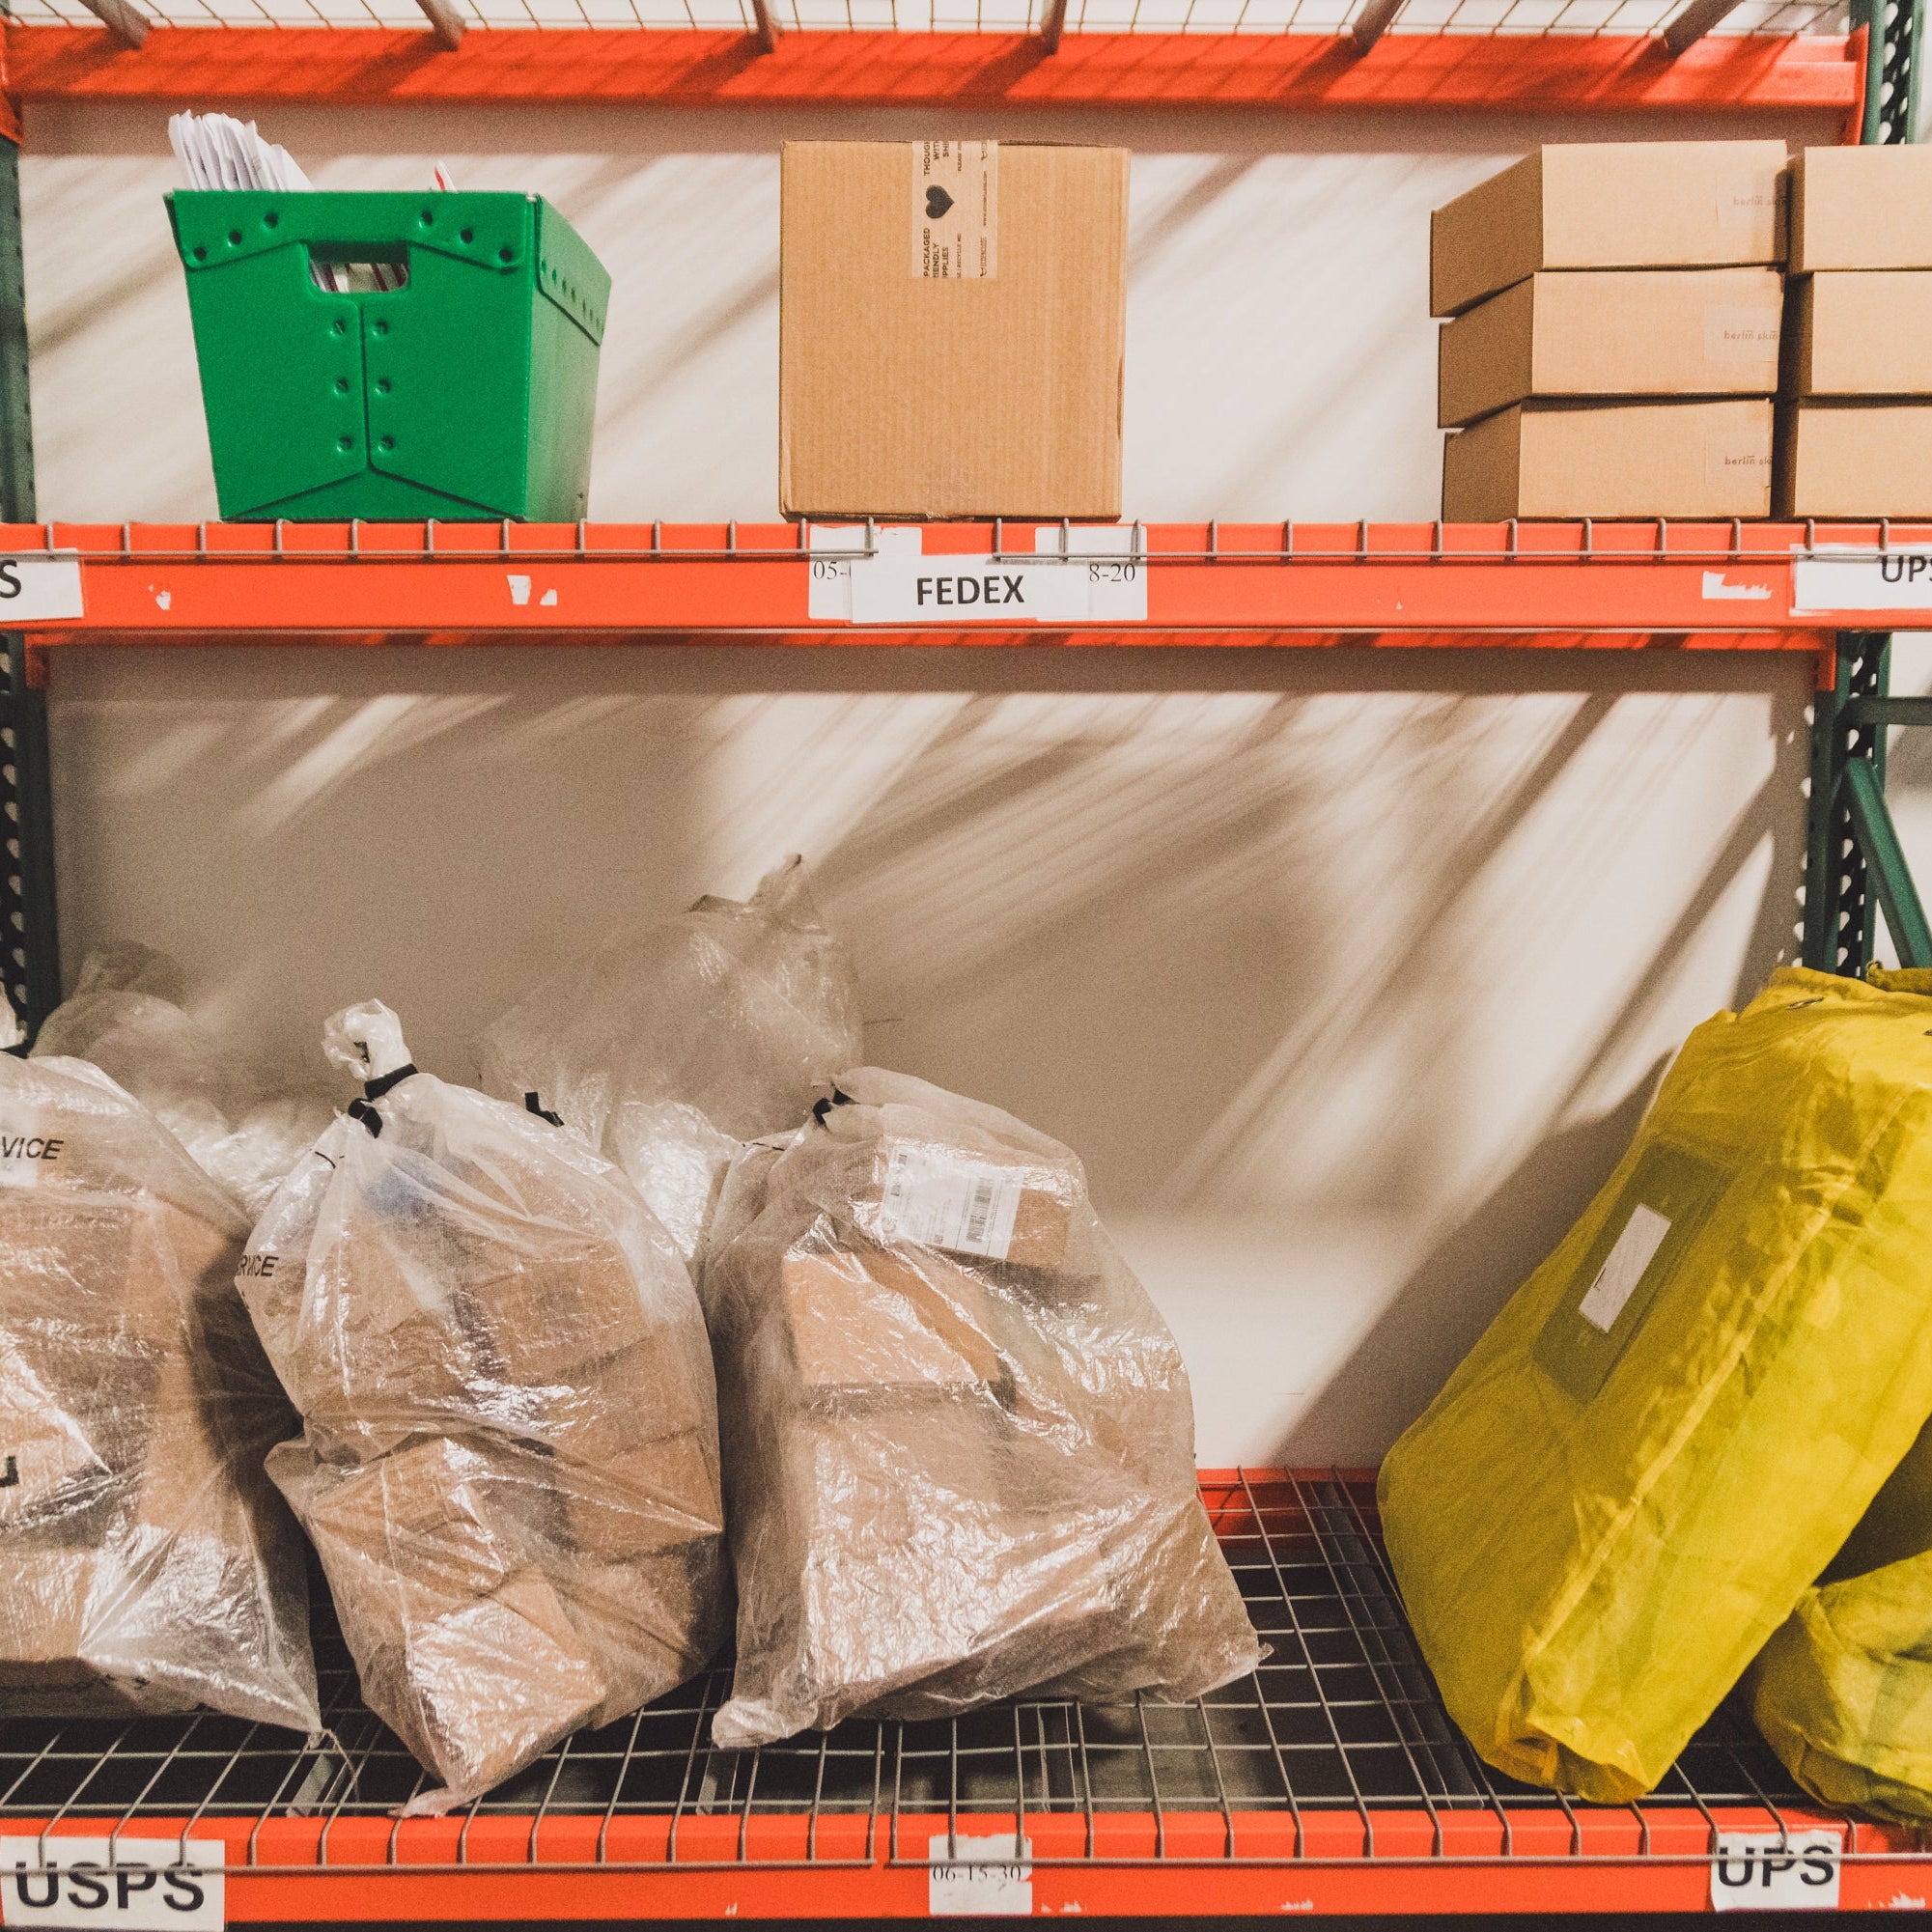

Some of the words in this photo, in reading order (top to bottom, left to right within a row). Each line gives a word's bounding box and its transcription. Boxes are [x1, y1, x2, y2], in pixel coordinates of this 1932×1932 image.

[1723, 330, 1754, 340] berlin
[1724, 456, 1755, 465] berlin
[0, 559, 21, 599] S
[813, 560, 852, 579] 05-
[1089, 563, 1135, 582] 8-20
[1882, 555, 1932, 582] UP
[916, 574, 1024, 606] FEDEX
[1, 1135, 64, 1160] VICE
[933, 1863, 1022, 1882] 06-15-30
[1718, 1845, 1834, 1887] UPS
[15, 1861, 205, 1912] USPS
